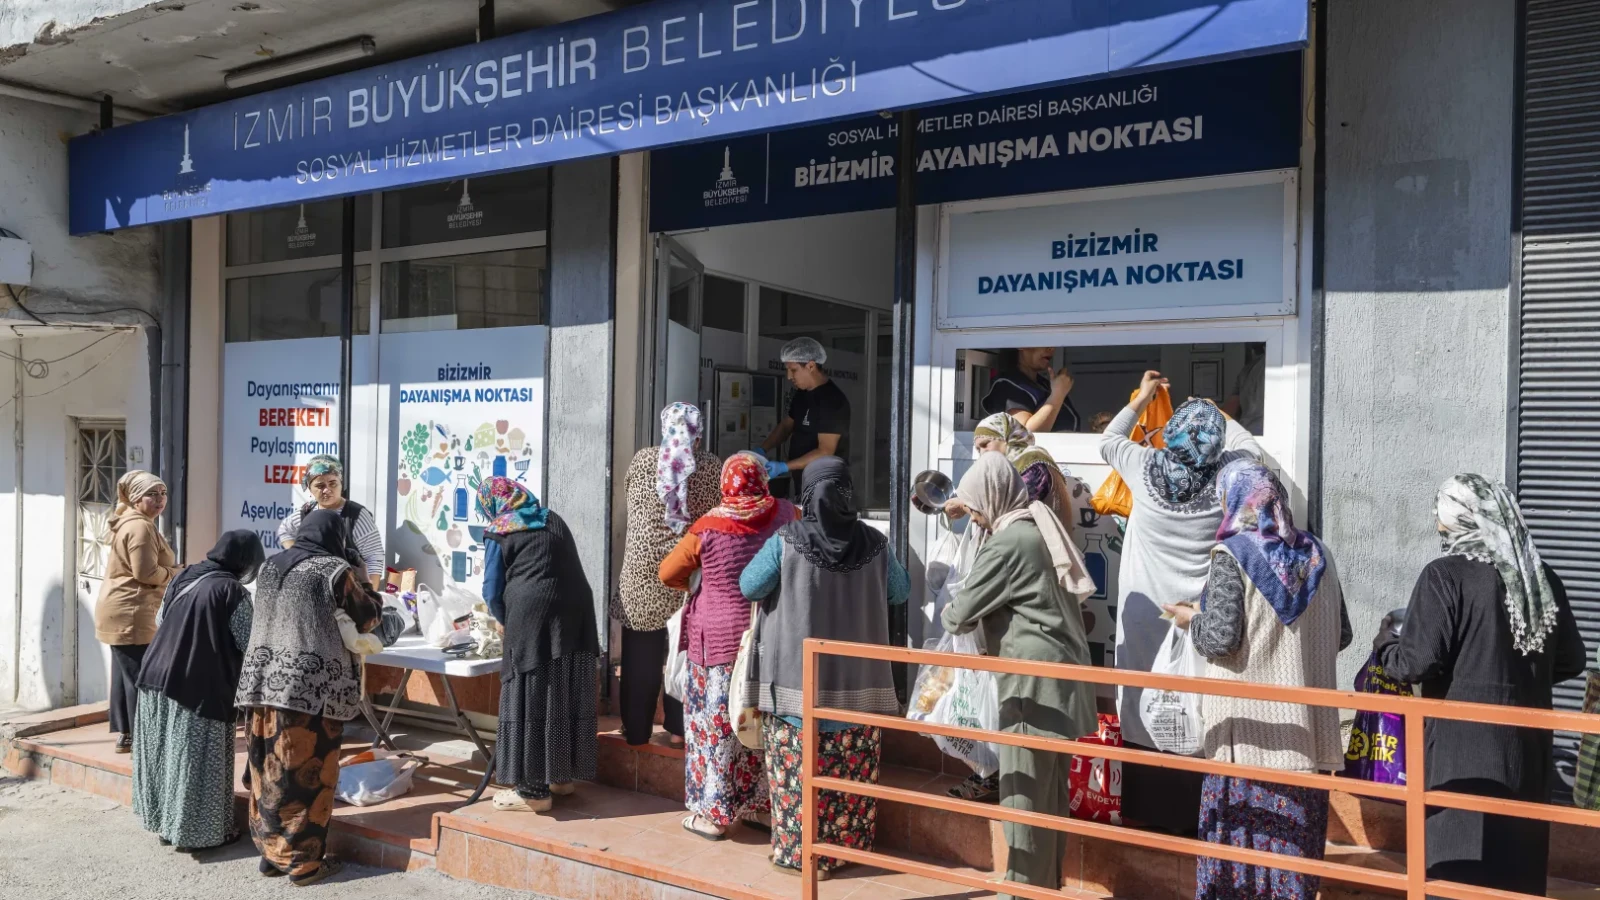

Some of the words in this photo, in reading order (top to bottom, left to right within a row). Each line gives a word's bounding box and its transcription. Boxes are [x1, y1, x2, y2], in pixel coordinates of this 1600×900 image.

[233, 96, 332, 151] İZMİR
[348, 37, 597, 128] BÜYÜKŞEHİR
[622, 0, 967, 74] BELEDİY
[296, 148, 378, 185] SOSYAL
[384, 122, 522, 171] HİZMETLER
[531, 93, 643, 145] DAİRESİ
[654, 57, 857, 126] BAŞKANLIĞI
[827, 126, 884, 147] SOSYAL
[888, 113, 973, 138] HMETLER
[978, 99, 1043, 126] DAİRESİ
[1047, 83, 1158, 117] BAŞKANLIĞI
[794, 150, 895, 188] BİZİZMİR
[916, 134, 1060, 173] AYANIŞMA
[1067, 115, 1203, 155] NOKTASI
[1051, 228, 1158, 260] BİZİZMİR
[978, 266, 1119, 294] DAYANIŞMA
[1126, 258, 1244, 286] NOKTASI
[437, 361, 492, 381] BİZİZMİR
[400, 388, 472, 406] DAYANIŞMA
[474, 387, 533, 402] NOKTASI
[259, 402, 330, 427] BEREKETİ
[250, 436, 338, 458] Paylaşmanın
[264, 464, 307, 484] LEZZE
[240, 500, 297, 522] Aşevleri
[951, 741, 971, 758] ATIK
